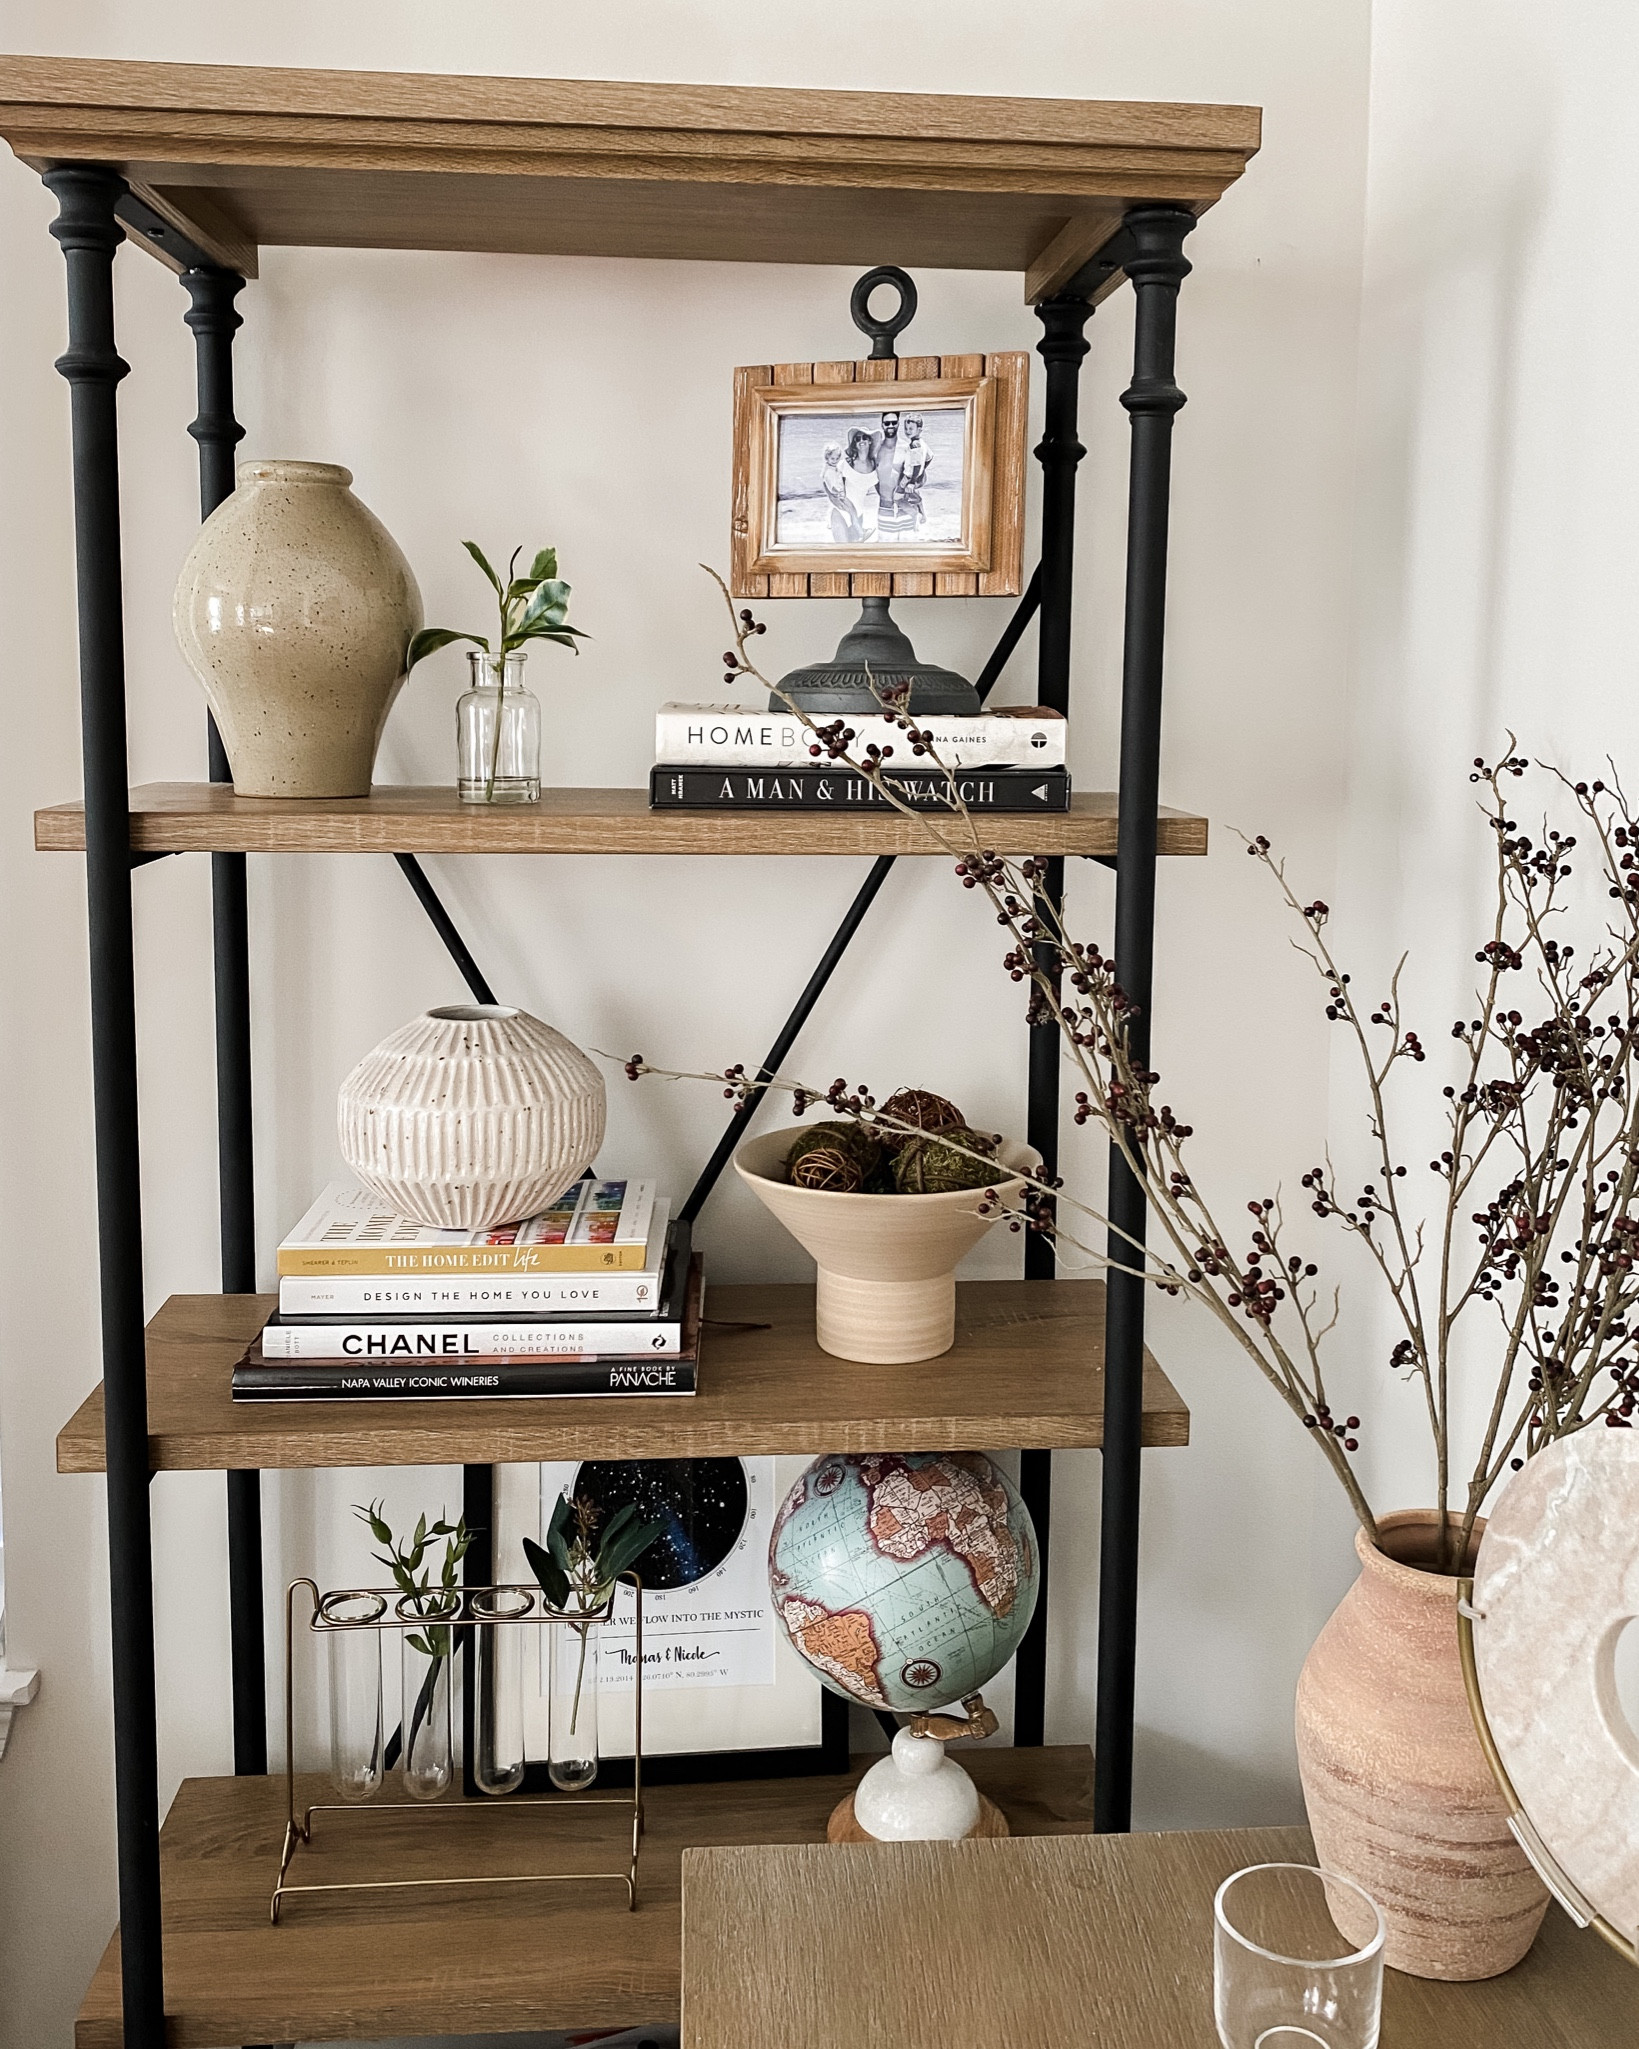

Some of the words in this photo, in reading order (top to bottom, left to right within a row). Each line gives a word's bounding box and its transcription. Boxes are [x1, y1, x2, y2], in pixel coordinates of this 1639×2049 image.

[688, 726, 866, 748] HOMEBOY
[718, 777, 735, 799] A
[746, 777, 804, 800] MAN
[816, 779, 835, 800] &
[846, 780, 890, 801] HIS
[903, 781, 995, 803] WATCH
[385, 1255, 419, 1268] THE
[422, 1254, 469, 1268] HOME
[472, 1253, 511, 1267] EDIT
[363, 1292, 423, 1301] DESIGN
[431, 1291, 461, 1301] THE
[469, 1291, 513, 1300] HOME
[521, 1290, 551, 1300] YOU
[560, 1290, 600, 1299] LOVE
[342, 1333, 479, 1355] CHANEL
[493, 1333, 584, 1342] COLLECTIONS
[519, 1345, 584, 1353] CREATIONS
[341, 1377, 370, 1389] NAPA
[373, 1377, 407, 1388] VALLEY
[409, 1376, 448, 1388] ICONIC
[450, 1376, 499, 1387] WINERIES
[609, 1372, 677, 1387] PANACHE
[619, 1616, 637, 1625] WE
[671, 1613, 698, 1623] INTO
[699, 1612, 722, 1621] THE
[724, 1609, 764, 1620] MYSTIC
[674, 1645, 721, 1662] Nicole
